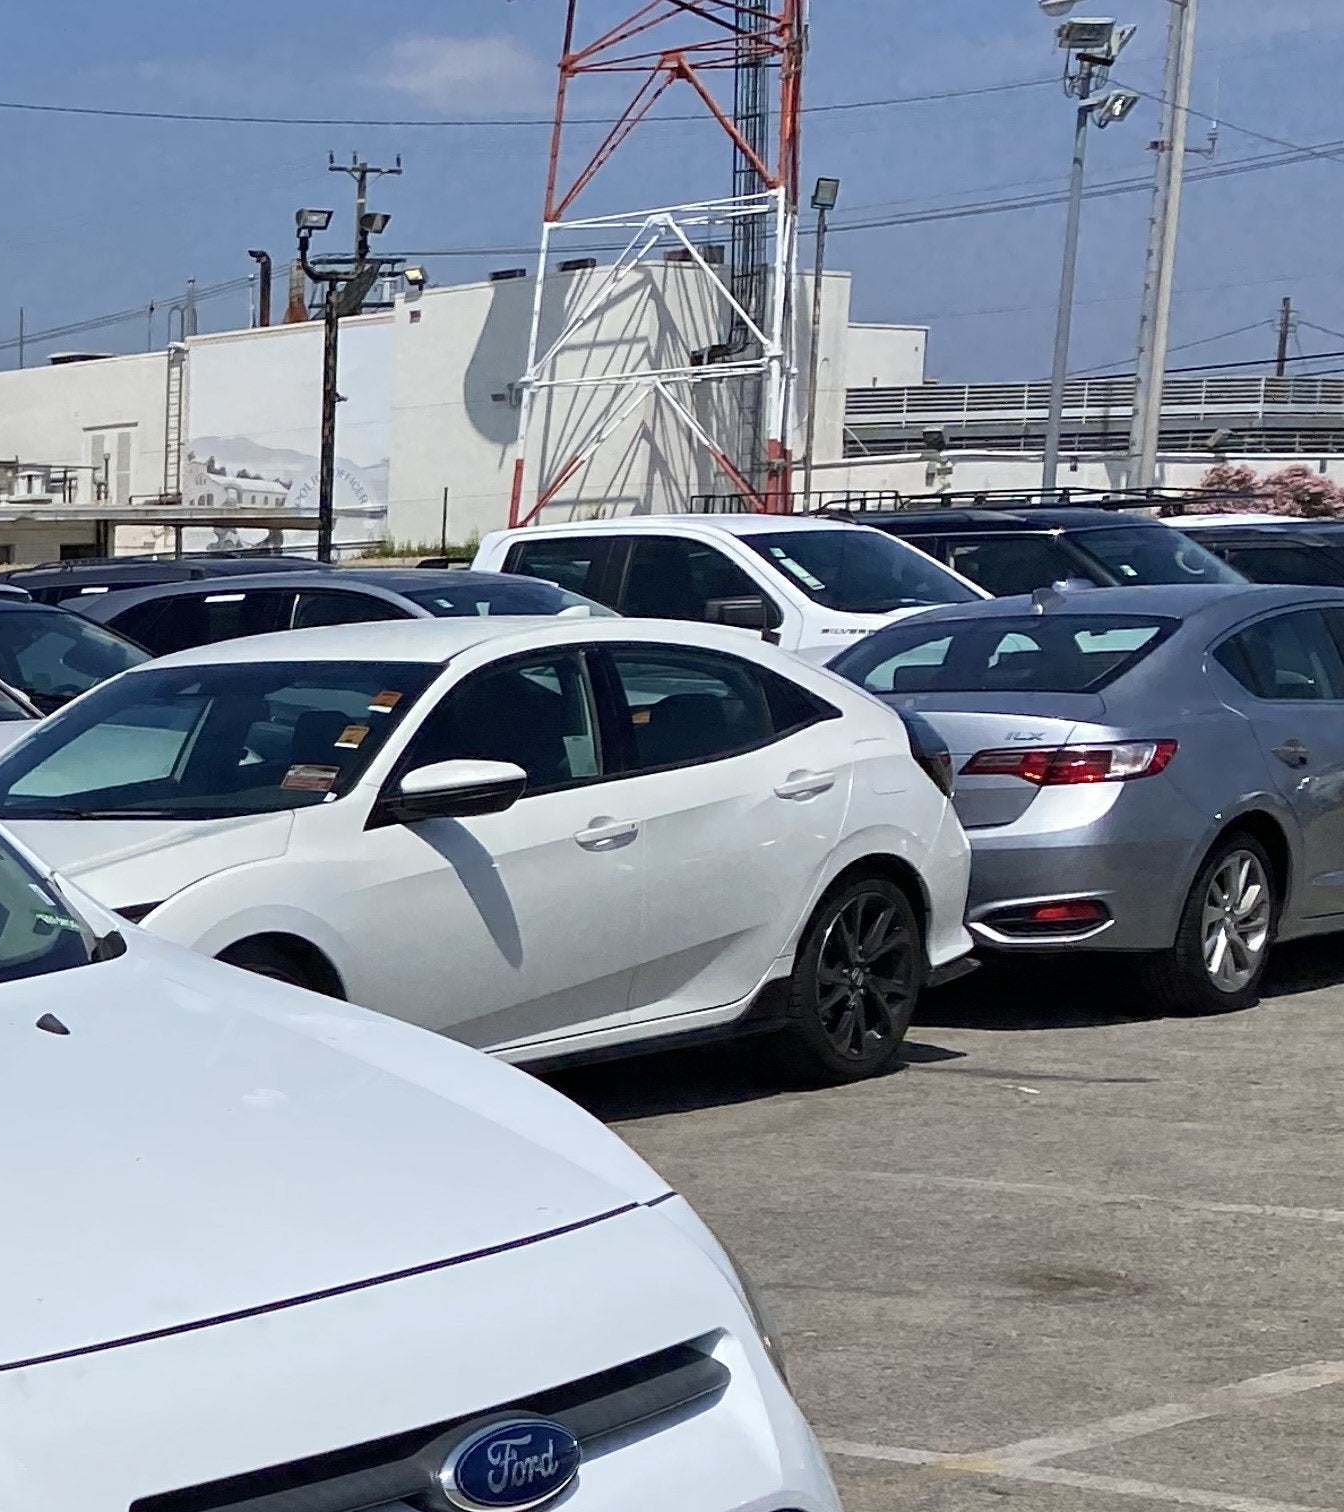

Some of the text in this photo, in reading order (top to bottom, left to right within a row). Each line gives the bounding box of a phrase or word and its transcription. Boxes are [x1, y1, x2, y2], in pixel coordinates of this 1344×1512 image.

[294, 470, 320, 507] POLIC
[1005, 731, 1047, 741] ILX
[486, 1433, 560, 1494] Ford
